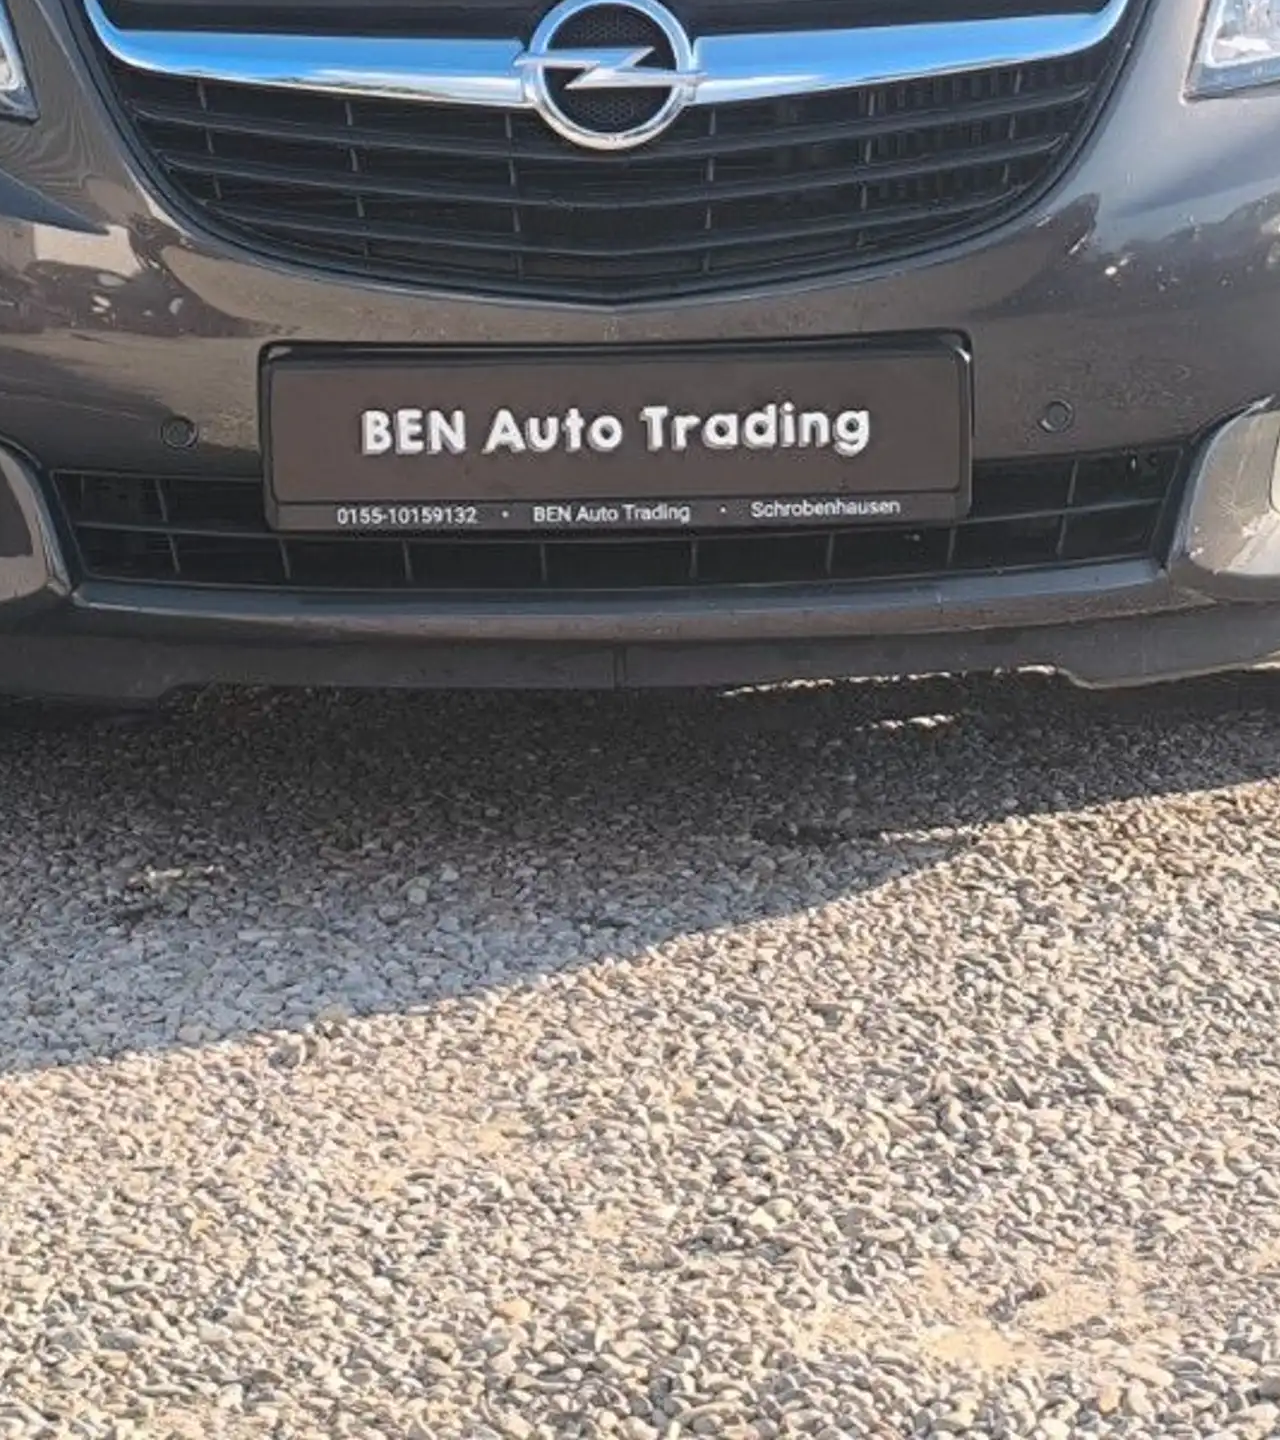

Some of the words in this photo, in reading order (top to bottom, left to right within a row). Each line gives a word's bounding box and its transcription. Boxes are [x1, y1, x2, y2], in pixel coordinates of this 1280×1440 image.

[361, 408, 466, 455] BEN
[481, 407, 621, 455] Auto
[641, 401, 870, 457] Trading
[337, 508, 477, 525] 0155-10159132
[533, 506, 571, 522] BEN
[575, 505, 619, 522] Auto
[621, 503, 691, 523] Trading
[750, 499, 901, 518] Schrobenhausen
